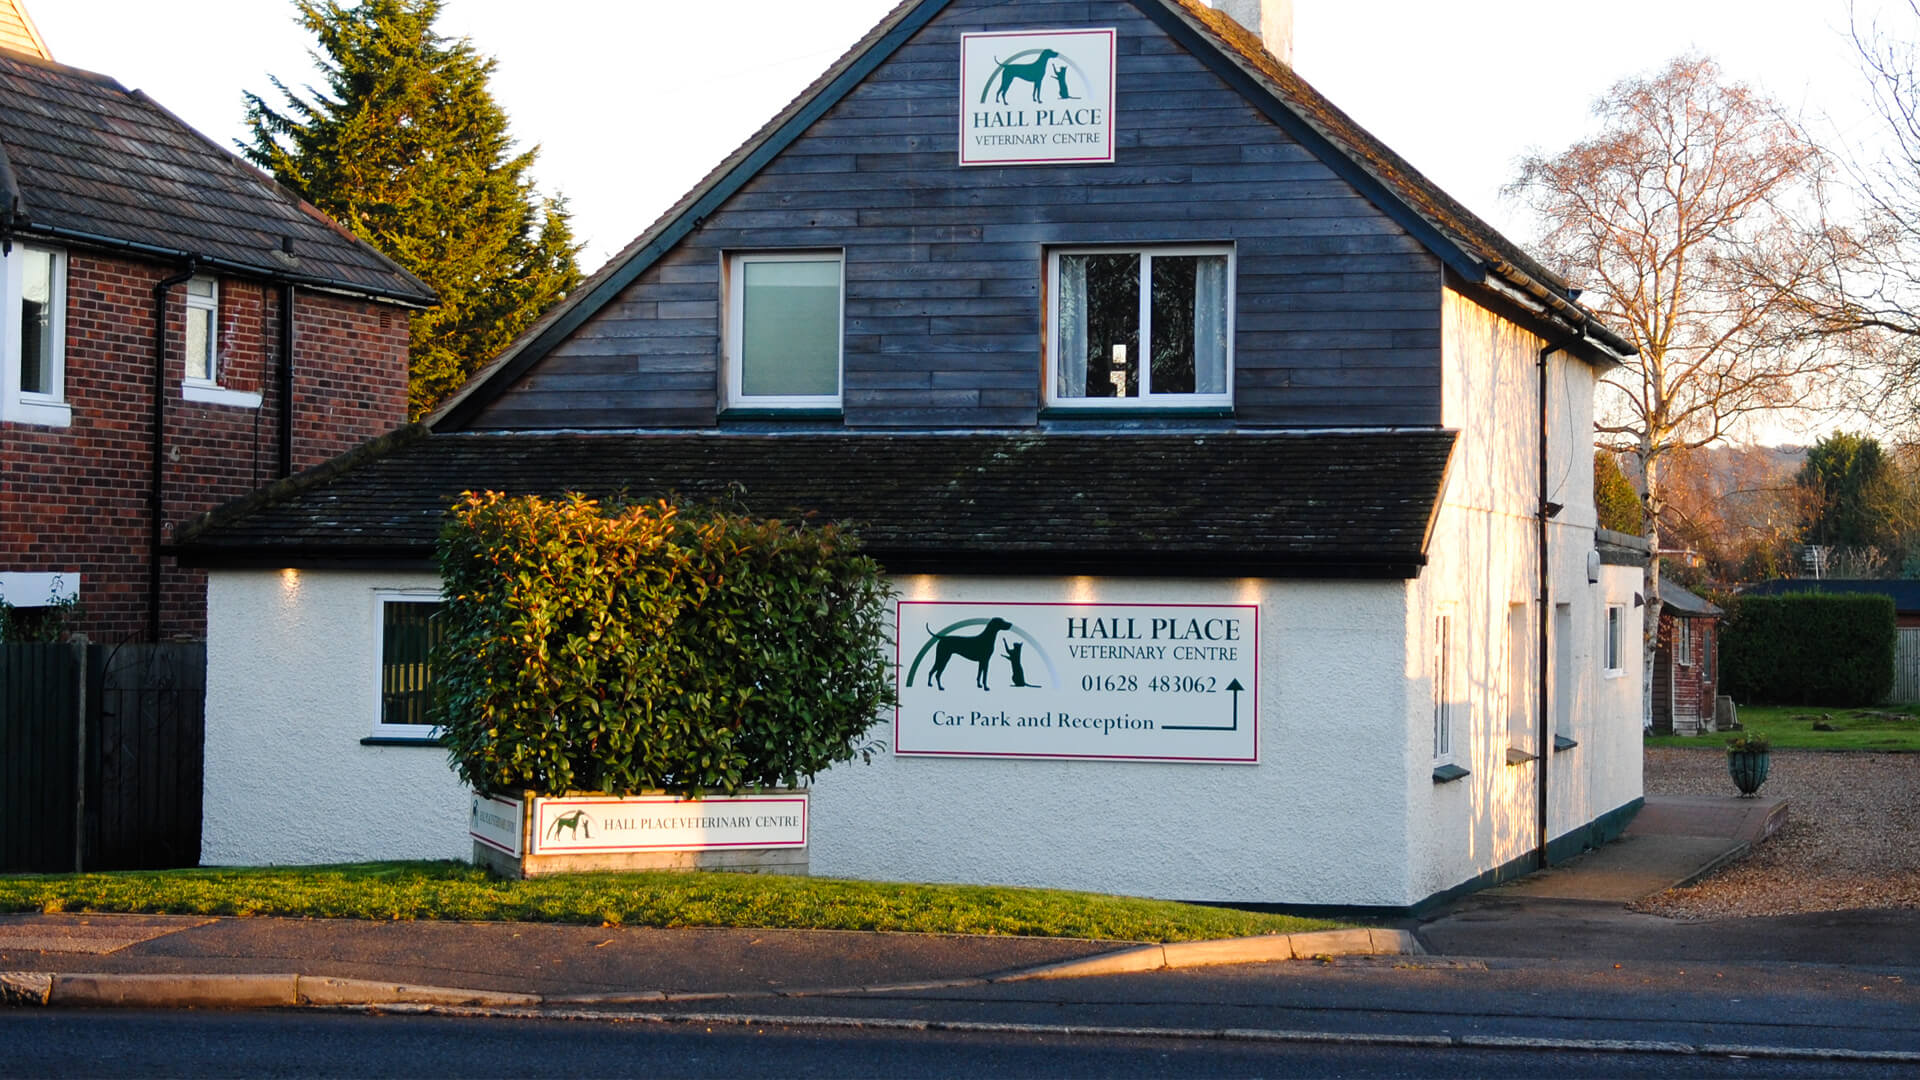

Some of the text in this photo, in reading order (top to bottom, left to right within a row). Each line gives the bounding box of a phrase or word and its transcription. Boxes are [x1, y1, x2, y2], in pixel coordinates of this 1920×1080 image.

[973, 108, 1101, 128] HALL PLACE
[975, 132, 1100, 146] VETERINARY CENTRE
[1066, 617, 1241, 641] HALL PLACE
[1069, 644, 1238, 662] VETERINARY CENTRE
[1081, 674, 1217, 694] 01628 483062
[932, 710, 1154, 735] Car Park and Reception
[604, 818, 637, 831] HALL
[755, 815, 800, 828] CENTRE
